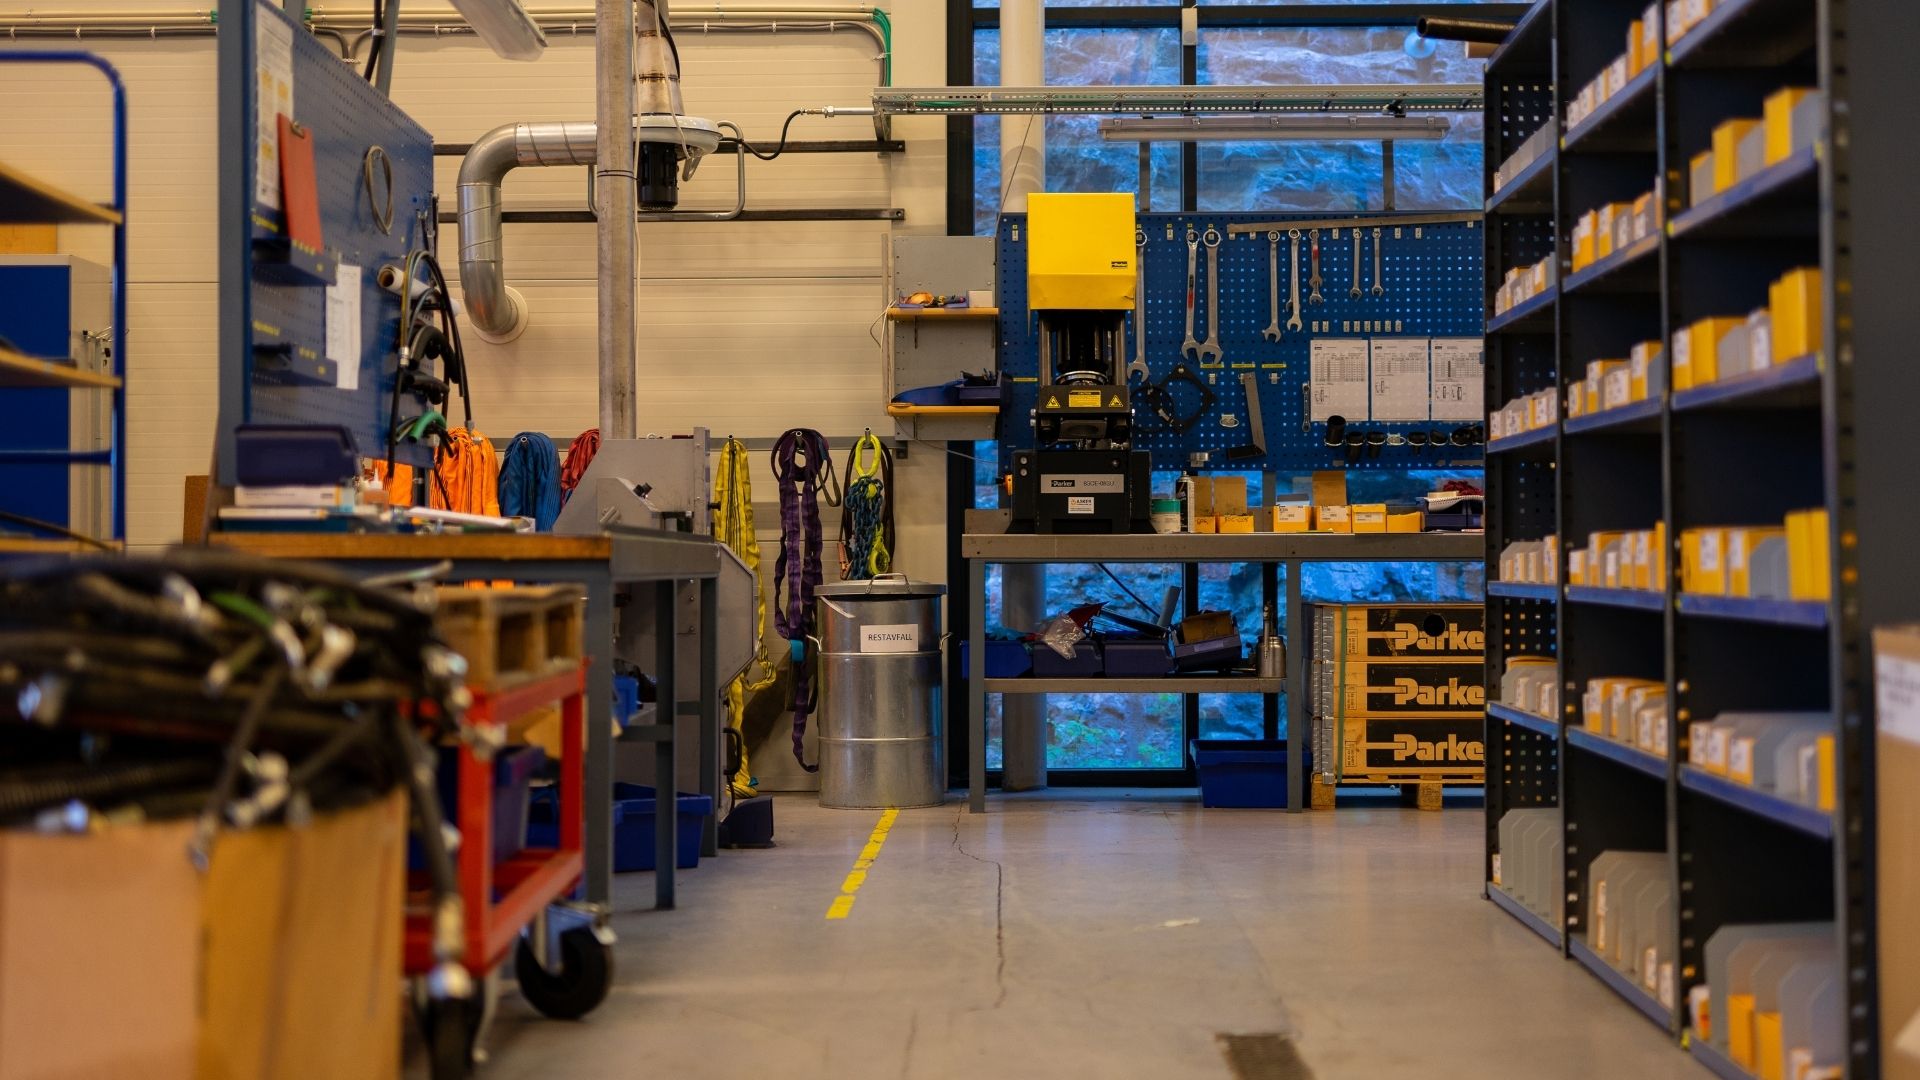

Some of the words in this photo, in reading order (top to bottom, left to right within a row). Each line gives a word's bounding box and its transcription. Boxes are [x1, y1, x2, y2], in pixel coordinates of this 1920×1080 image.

[868, 633, 913, 641] RESTAVFALL
[1395, 622, 1485, 650] Parke
[1395, 677, 1485, 705] Parke
[1394, 733, 1485, 761] Parke
